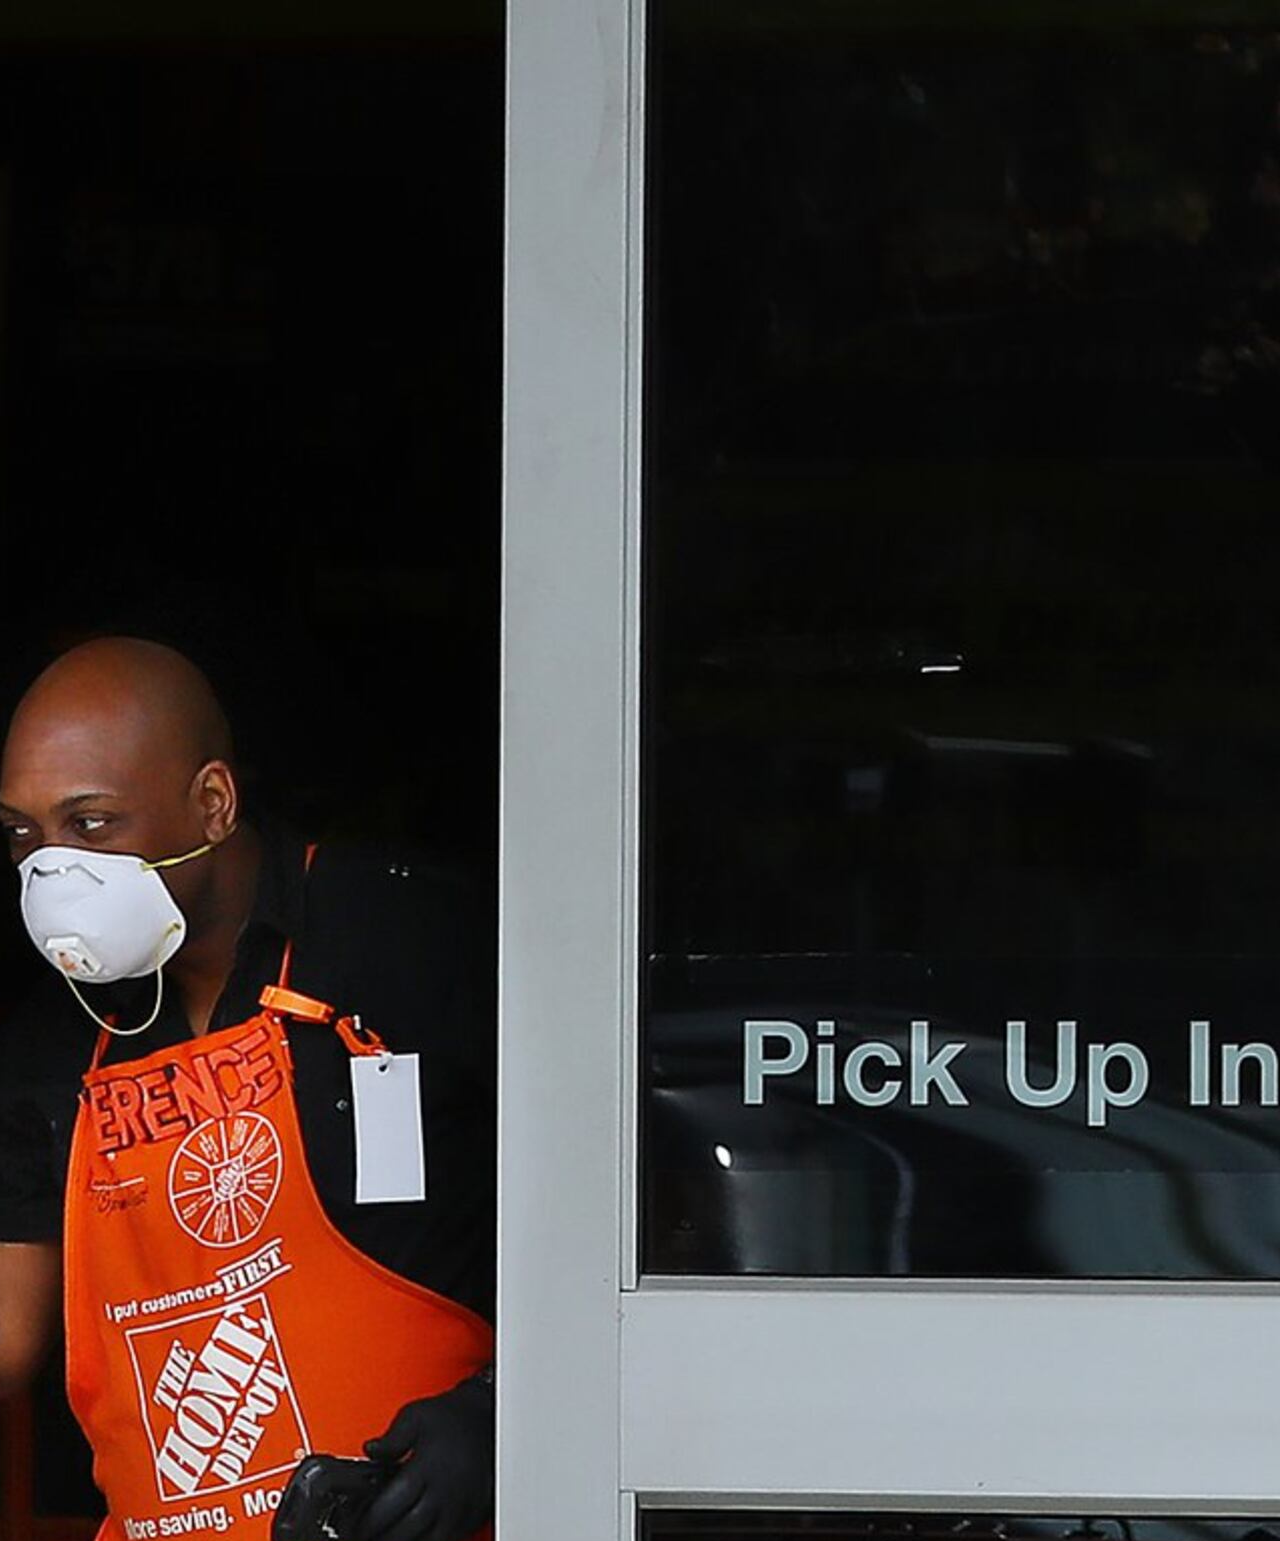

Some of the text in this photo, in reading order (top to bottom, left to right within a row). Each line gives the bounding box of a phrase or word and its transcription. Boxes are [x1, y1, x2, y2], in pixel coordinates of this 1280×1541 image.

[742, 1020, 1280, 1127] Pick Up In
[105, 1246, 284, 1324] I put customers FIRST
[153, 1304, 290, 1496] THE HOME DEPOT
[159, 1506, 235, 1538] saving.
[243, 1485, 286, 1517] Mo
